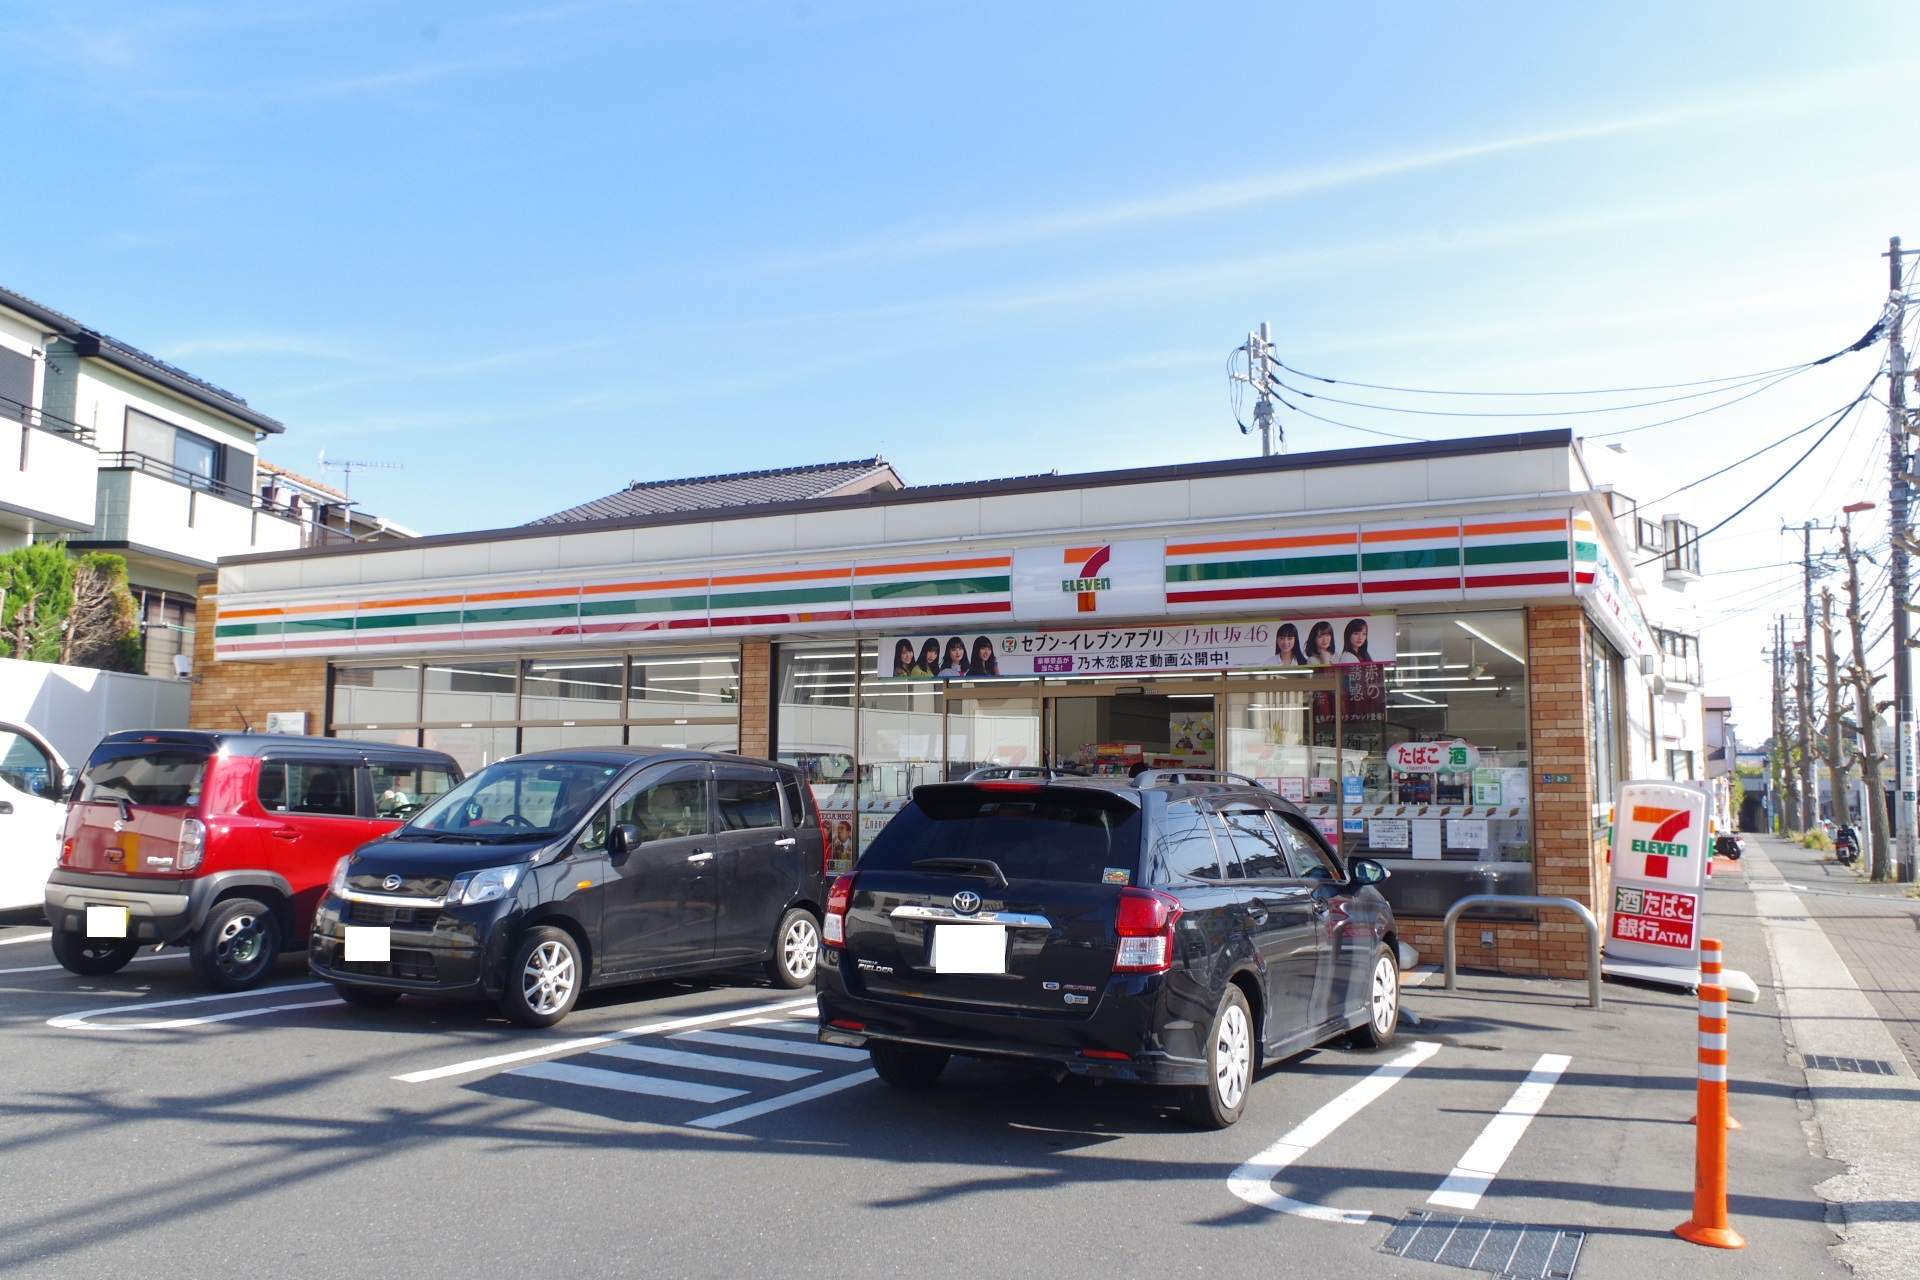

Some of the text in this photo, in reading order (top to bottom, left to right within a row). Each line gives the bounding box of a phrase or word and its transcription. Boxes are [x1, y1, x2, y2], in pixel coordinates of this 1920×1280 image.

[1077, 652, 1230, 670] 乃木恋限定動画公開中!
[1398, 747, 1467, 765] たばこ 酒
[1616, 888, 1693, 920] 酒 たばこ
